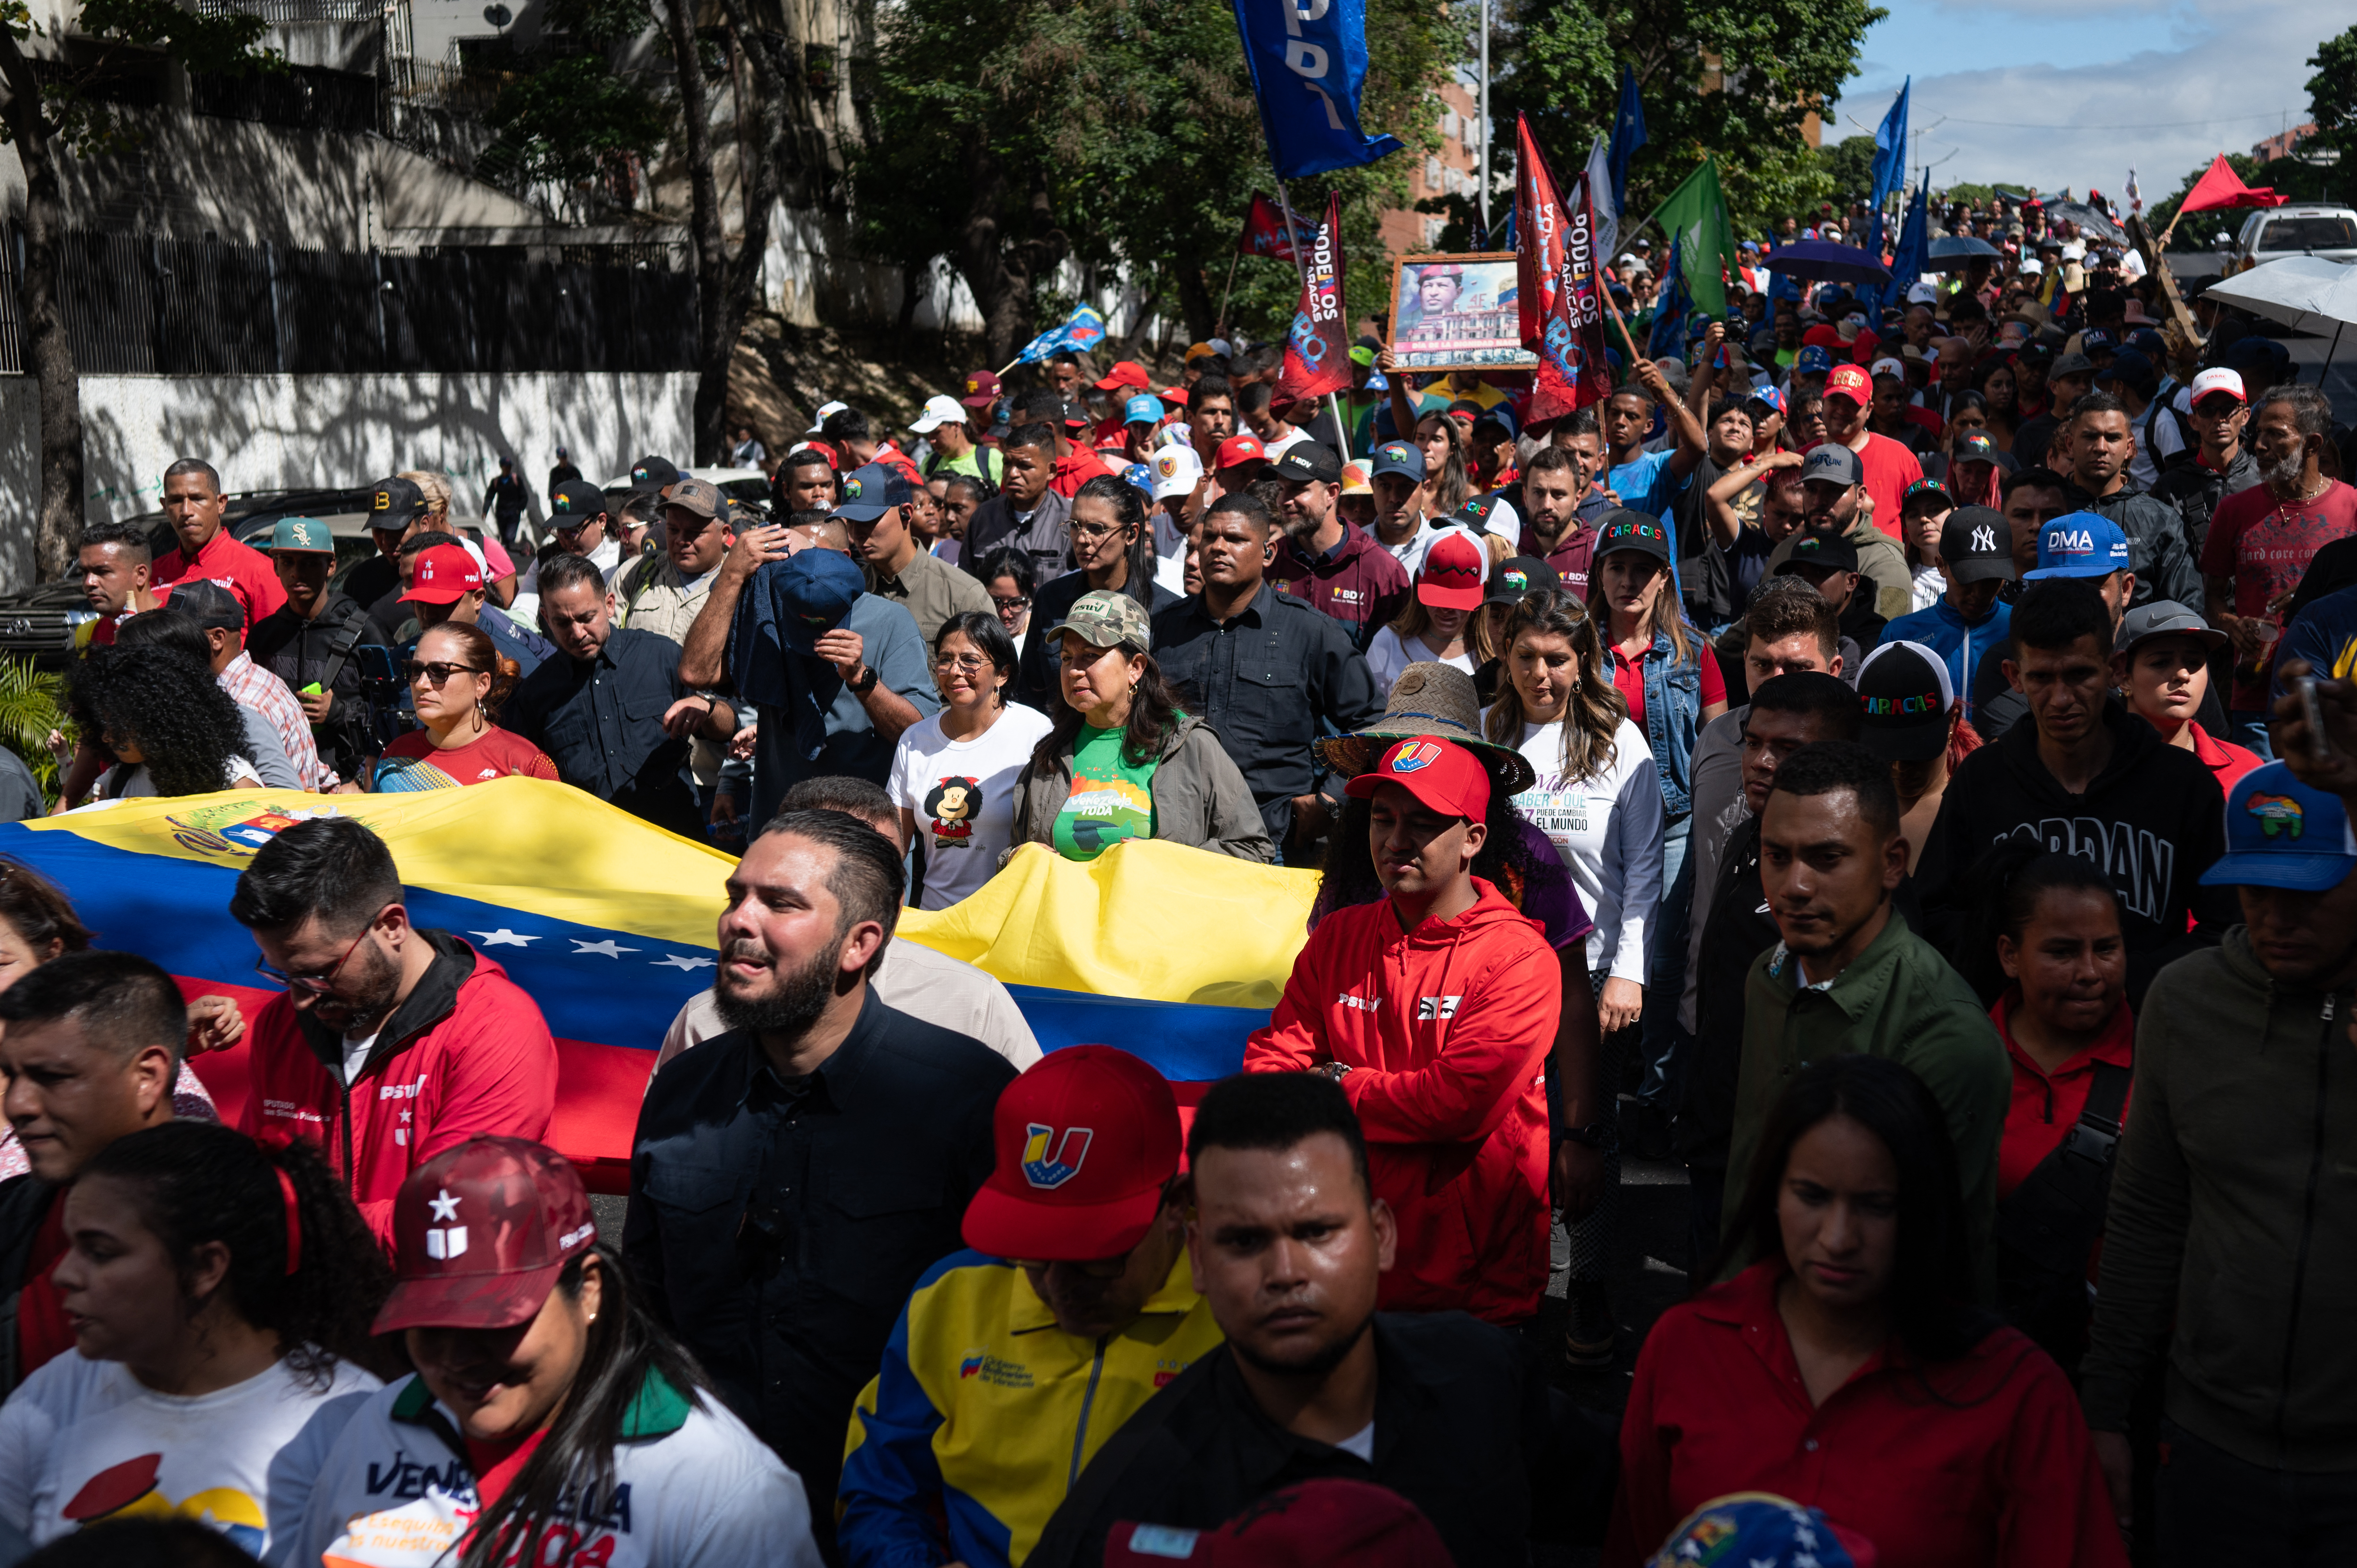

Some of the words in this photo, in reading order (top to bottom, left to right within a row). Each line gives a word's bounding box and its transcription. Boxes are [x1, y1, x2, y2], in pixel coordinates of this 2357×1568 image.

[1453, 339, 1494, 348] DIGNIDAD
[1496, 338, 1522, 346] NACIO
[1295, 456, 1312, 469] BDV
[292, 523, 311, 546] Sox
[1608, 524, 1662, 540] CARACAS
[1971, 525, 1997, 552] NY
[2048, 530, 2094, 548] DMA
[1568, 572, 1589, 582] BDV
[1861, 693, 1937, 715] CARACAS
[1564, 793, 1586, 808] QUE
[1081, 805, 1113, 817] TODA
[1558, 809, 1586, 817] CAMBIAR
[1537, 817, 1548, 830] EL
[1551, 817, 1587, 831] MUNDO
[1549, 835, 1568, 844] ACÓN
